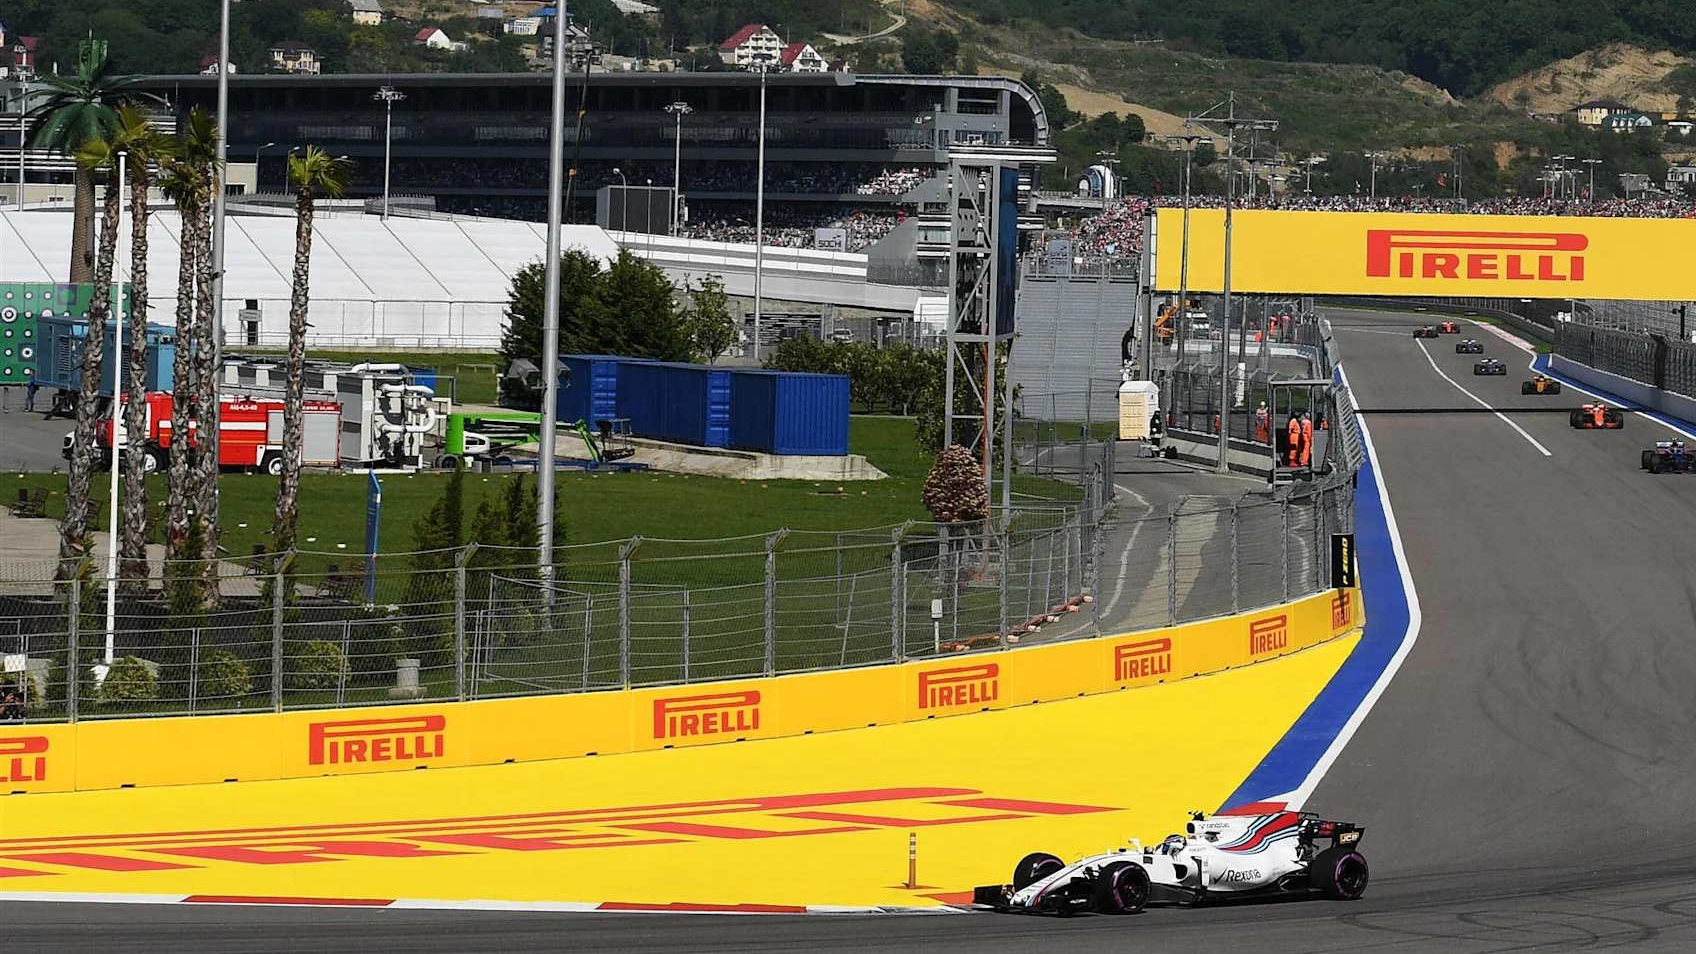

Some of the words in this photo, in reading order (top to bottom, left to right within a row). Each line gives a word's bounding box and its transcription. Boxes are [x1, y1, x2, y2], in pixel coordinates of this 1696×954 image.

[1367, 230, 1588, 280] PIRELLI
[1341, 537, 1349, 574] ZERO
[1250, 615, 1287, 655] PIRELLI
[1115, 639, 1172, 681] PIRELLI
[919, 664, 999, 709] PIRELLI
[654, 691, 761, 739] PIRELLI
[309, 715, 446, 765] PIRELLI
[1341, 834, 1358, 842] JCB
[1226, 869, 1262, 882] Rexona
